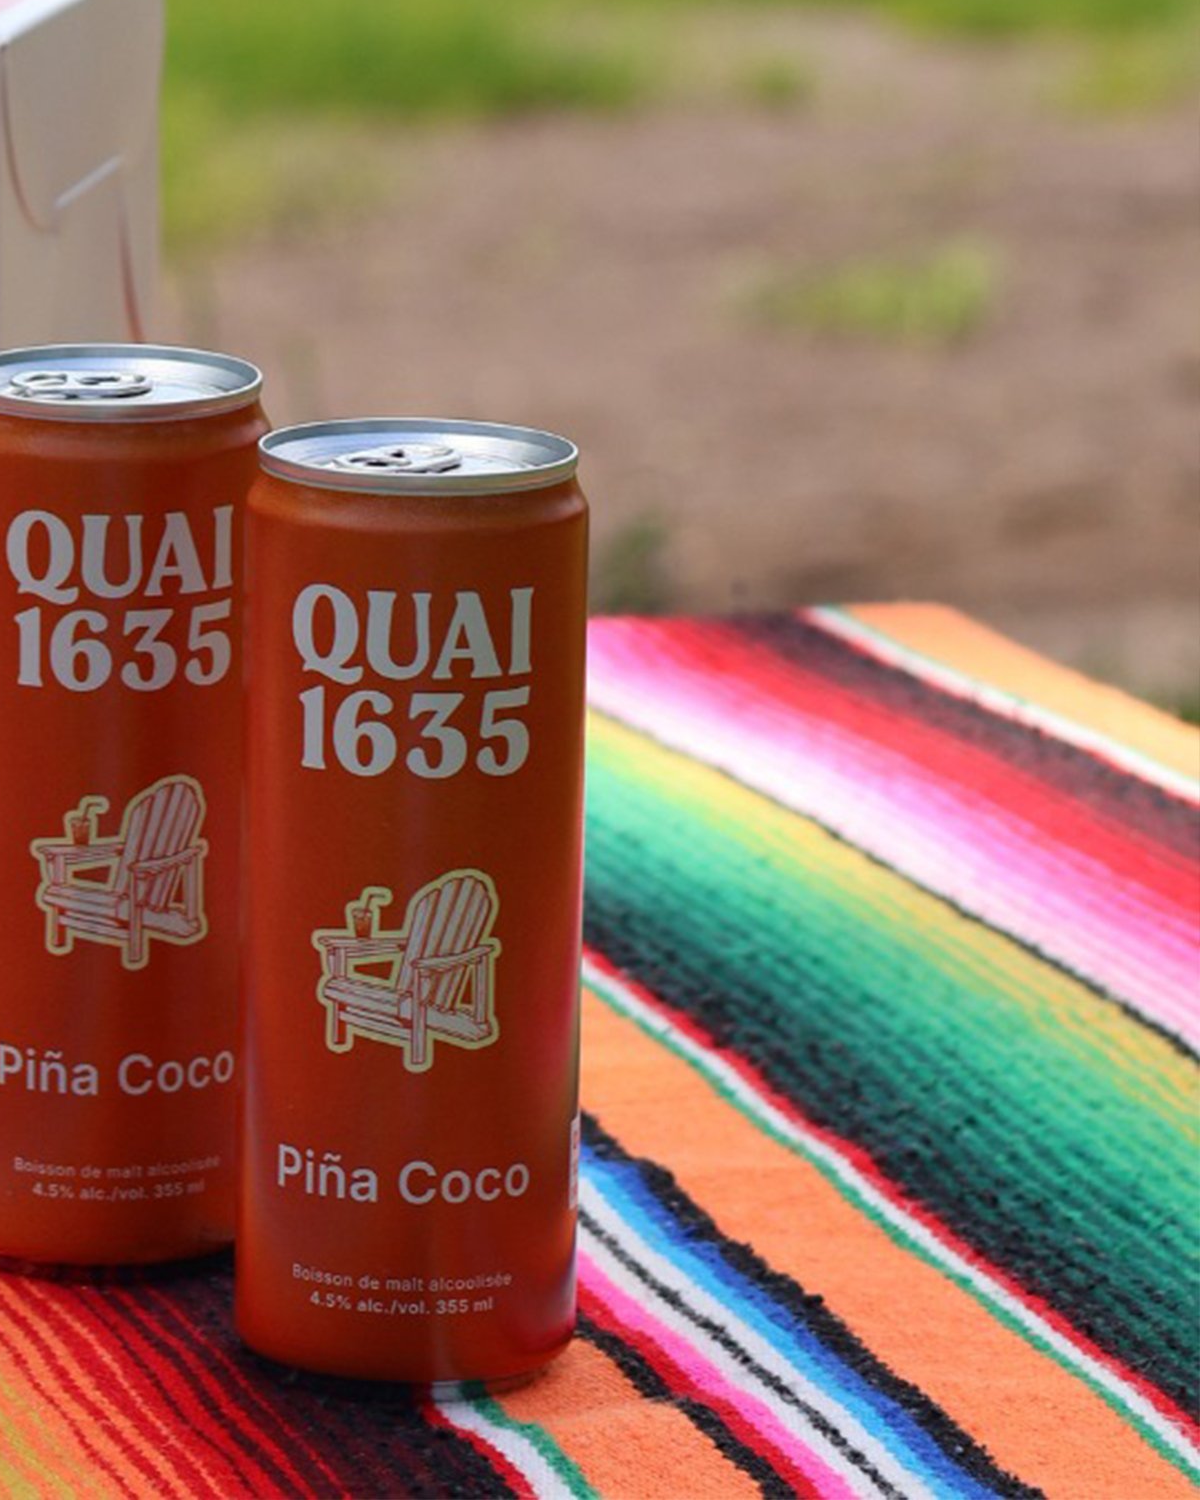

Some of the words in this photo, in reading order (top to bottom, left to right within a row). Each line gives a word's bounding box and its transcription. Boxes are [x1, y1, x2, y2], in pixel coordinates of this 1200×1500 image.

[6, 505, 233, 604] QUAI
[14, 599, 231, 691] 1635
[292, 583, 534, 684] QUAI
[299, 686, 530, 778] 1635
[118, 1051, 234, 1095] Coco
[13, 1156, 76, 1177] Boisson
[80, 1165, 101, 1179] de
[106, 1165, 142, 1179] malt
[32, 1182, 74, 1199] 4.5%
[155, 1183, 184, 1198] 355
[278, 1144, 378, 1202] Piña
[399, 1161, 530, 1204] Coco
[292, 1263, 352, 1287] Boisson
[359, 1275, 379, 1290] de
[386, 1277, 423, 1292] malt
[310, 1291, 350, 1310] 4.5%
[437, 1299, 469, 1315] 355
[473, 1297, 493, 1312] ml
